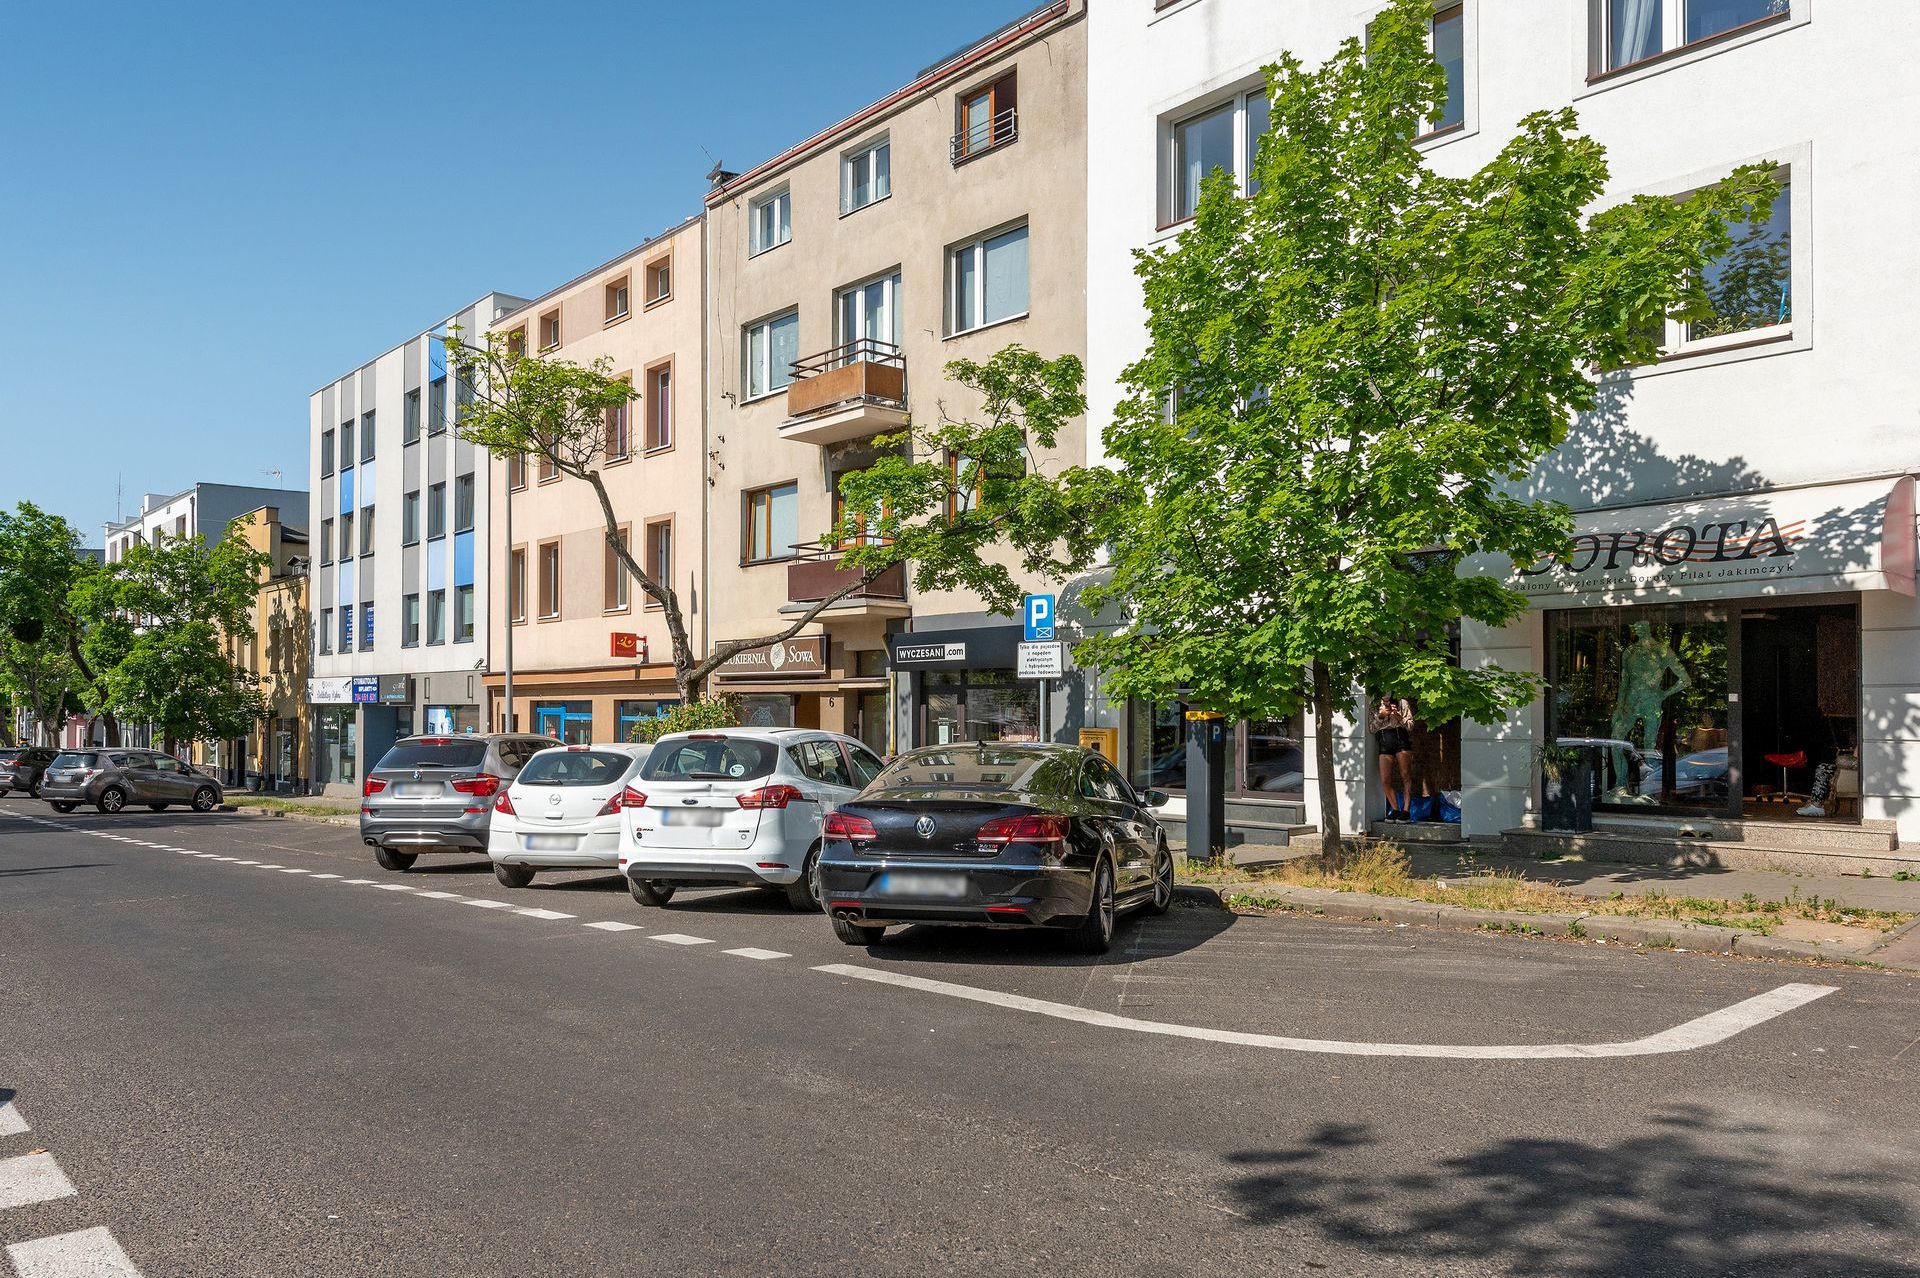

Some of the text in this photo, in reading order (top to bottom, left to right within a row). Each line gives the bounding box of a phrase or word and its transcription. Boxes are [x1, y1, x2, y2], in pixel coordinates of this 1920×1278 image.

[1514, 583, 1551, 591] salony
[1556, 577, 1624, 589] fryzjerskie
[1630, 573, 1674, 583] Doroty
[1718, 564, 1794, 578] Jakimczyk
[1031, 598, 1048, 628] P
[899, 648, 964, 659] WYCZESANI .com
[829, 696, 835, 708] 6
[1212, 725, 1220, 739] P
